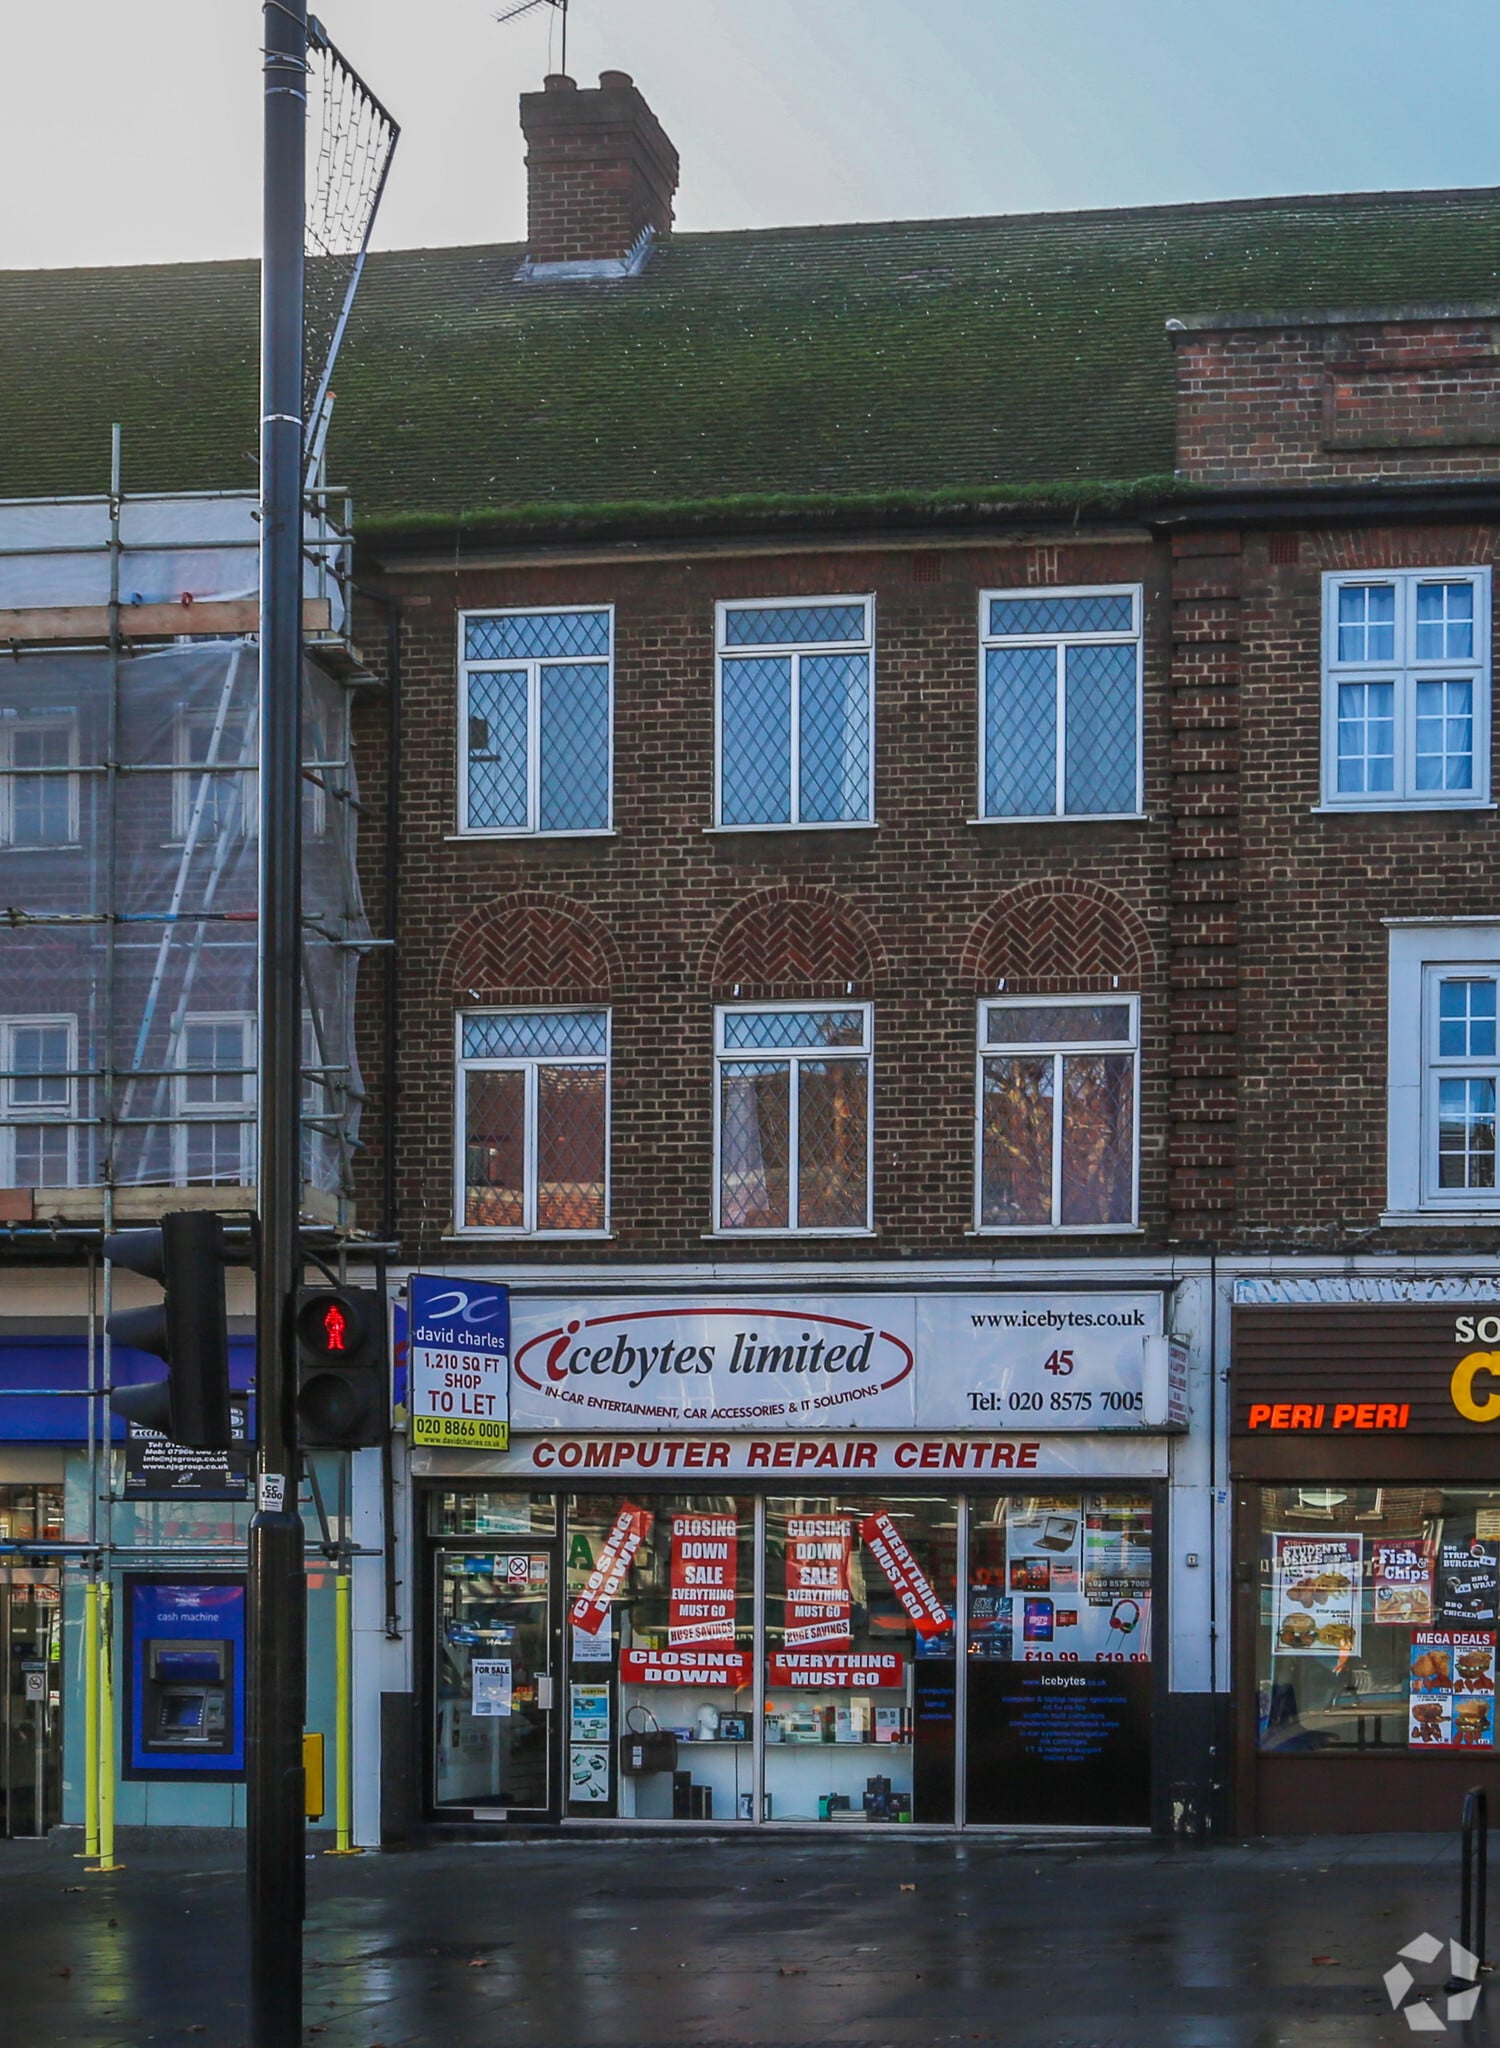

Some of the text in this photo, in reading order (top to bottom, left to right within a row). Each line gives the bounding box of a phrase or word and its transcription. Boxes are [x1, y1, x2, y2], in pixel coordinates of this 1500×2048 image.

[971, 1309, 1145, 1330] www.icebytes.co.uk
[416, 1326, 505, 1348] david charles
[546, 1319, 875, 1388] icebytes limited
[424, 1352, 458, 1370] 1.210
[462, 1356, 480, 1372] SQ
[484, 1358, 499, 1374] FT
[1044, 1350, 1073, 1376] 45
[444, 1373, 482, 1389] SHOP
[428, 1390, 496, 1415] TO LET
[545, 1384, 879, 1419] IN-CAR ENTERTAINMENT, CAR ACCESSORIES & IT SOLUTIONS
[967, 1391, 1143, 1411] Tel: 020 8575 7005
[1248, 1404, 1410, 1429] PERI PERI
[416, 1418, 505, 1438] 020 8866 0001
[532, 1442, 1040, 1468] COMPUTER REPAIR CENTRE
[261, 1491, 283, 1500] 1200
[265, 1485, 279, 1493] CC
[673, 1519, 736, 1537] CLOSING
[787, 1520, 850, 1537] CLOSING
[681, 1542, 728, 1560] DOWN
[796, 1543, 842, 1560] DOWN
[1283, 1543, 1347, 1555] STUDENTS
[1379, 1549, 1417, 1564] Fish
[573, 1512, 634, 1619] CLOSING
[594, 1533, 641, 1613] DOWN
[876, 1515, 947, 1624] EVERYTHING
[1443, 1560, 1480, 1568] BURGER
[685, 1566, 723, 1585] SALE
[801, 1567, 838, 1585] SALE
[869, 1538, 924, 1619] MUST GO
[1384, 1566, 1429, 1584] Chips
[1472, 1580, 1496, 1589] WRAP
[671, 1588, 734, 1601] EVERYTHING
[787, 1589, 849, 1602] EVERYTHING
[157, 1612, 219, 1622] cash machine
[679, 1604, 726, 1617] MUST GO
[795, 1605, 841, 1618] MUST GO
[1443, 1609, 1478, 1618] CHICKEN
[670, 1621, 733, 1641] HUGE SAVINGS
[786, 1622, 848, 1643] HUGE SAVINGS
[1416, 1633, 1490, 1645] MEGA DEALS
[629, 1651, 743, 1666] CLOSING
[775, 1654, 896, 1668] EVERYTHING
[475, 1666, 510, 1674] FOR SALE
[644, 1669, 727, 1683] DOWN
[791, 1672, 880, 1685] MUST GO
